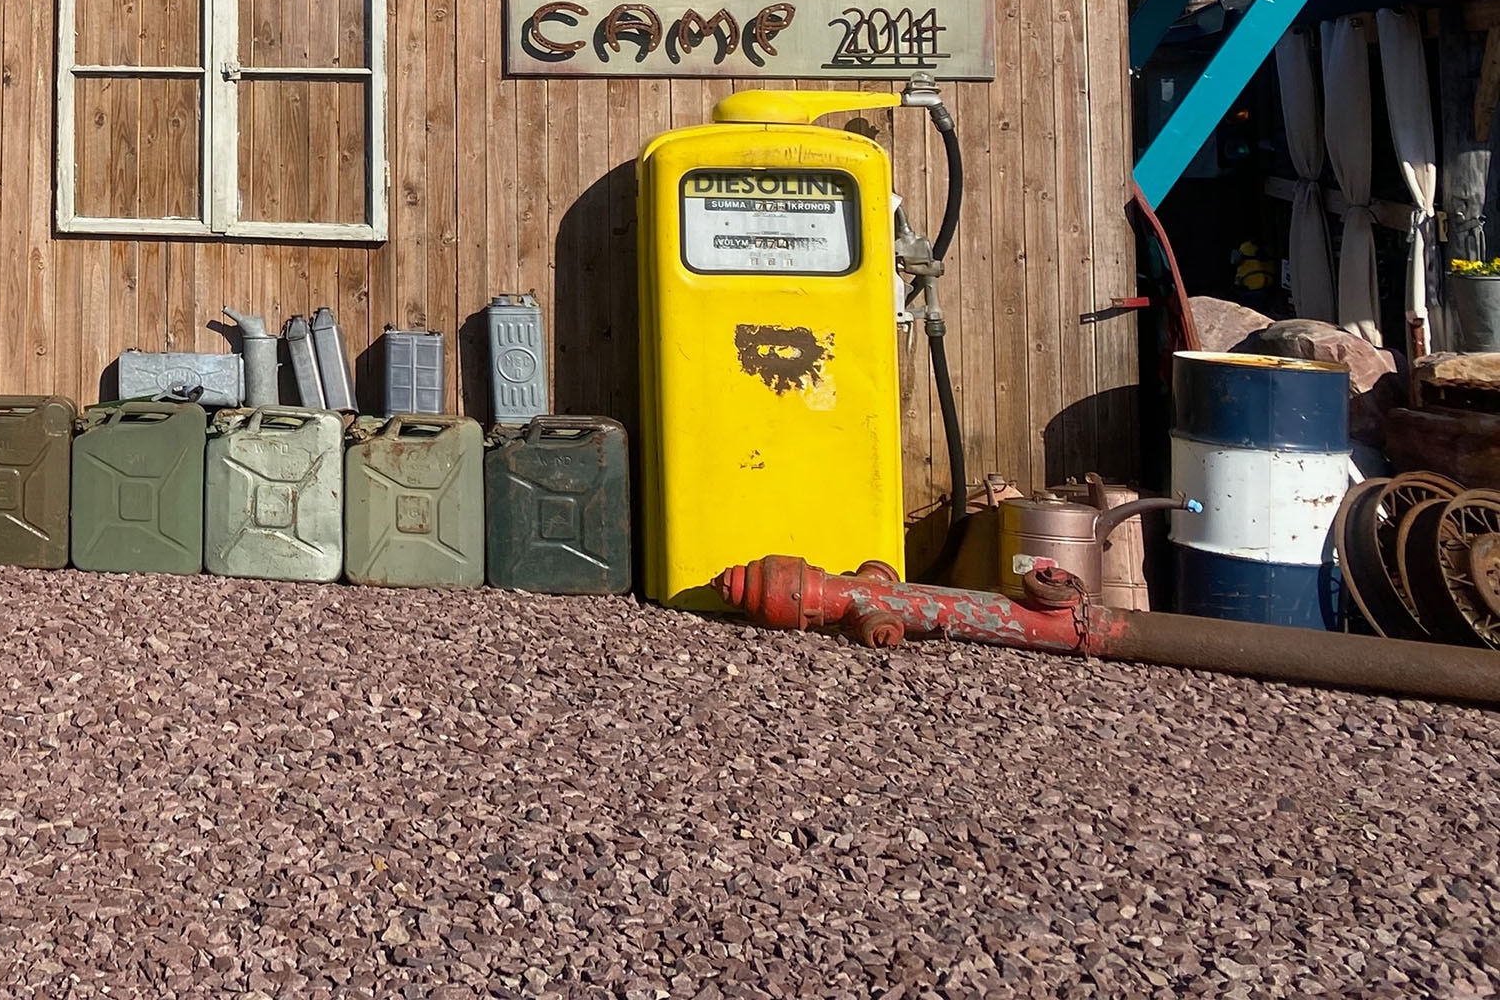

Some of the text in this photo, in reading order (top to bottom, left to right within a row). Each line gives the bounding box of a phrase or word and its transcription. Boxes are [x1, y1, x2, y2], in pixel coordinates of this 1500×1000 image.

[528, 0, 950, 60] CAMP 2014
[711, 200, 747, 209] SUMMA
[791, 201, 831, 212] KRONOR
[717, 238, 749, 247] VOLYM
